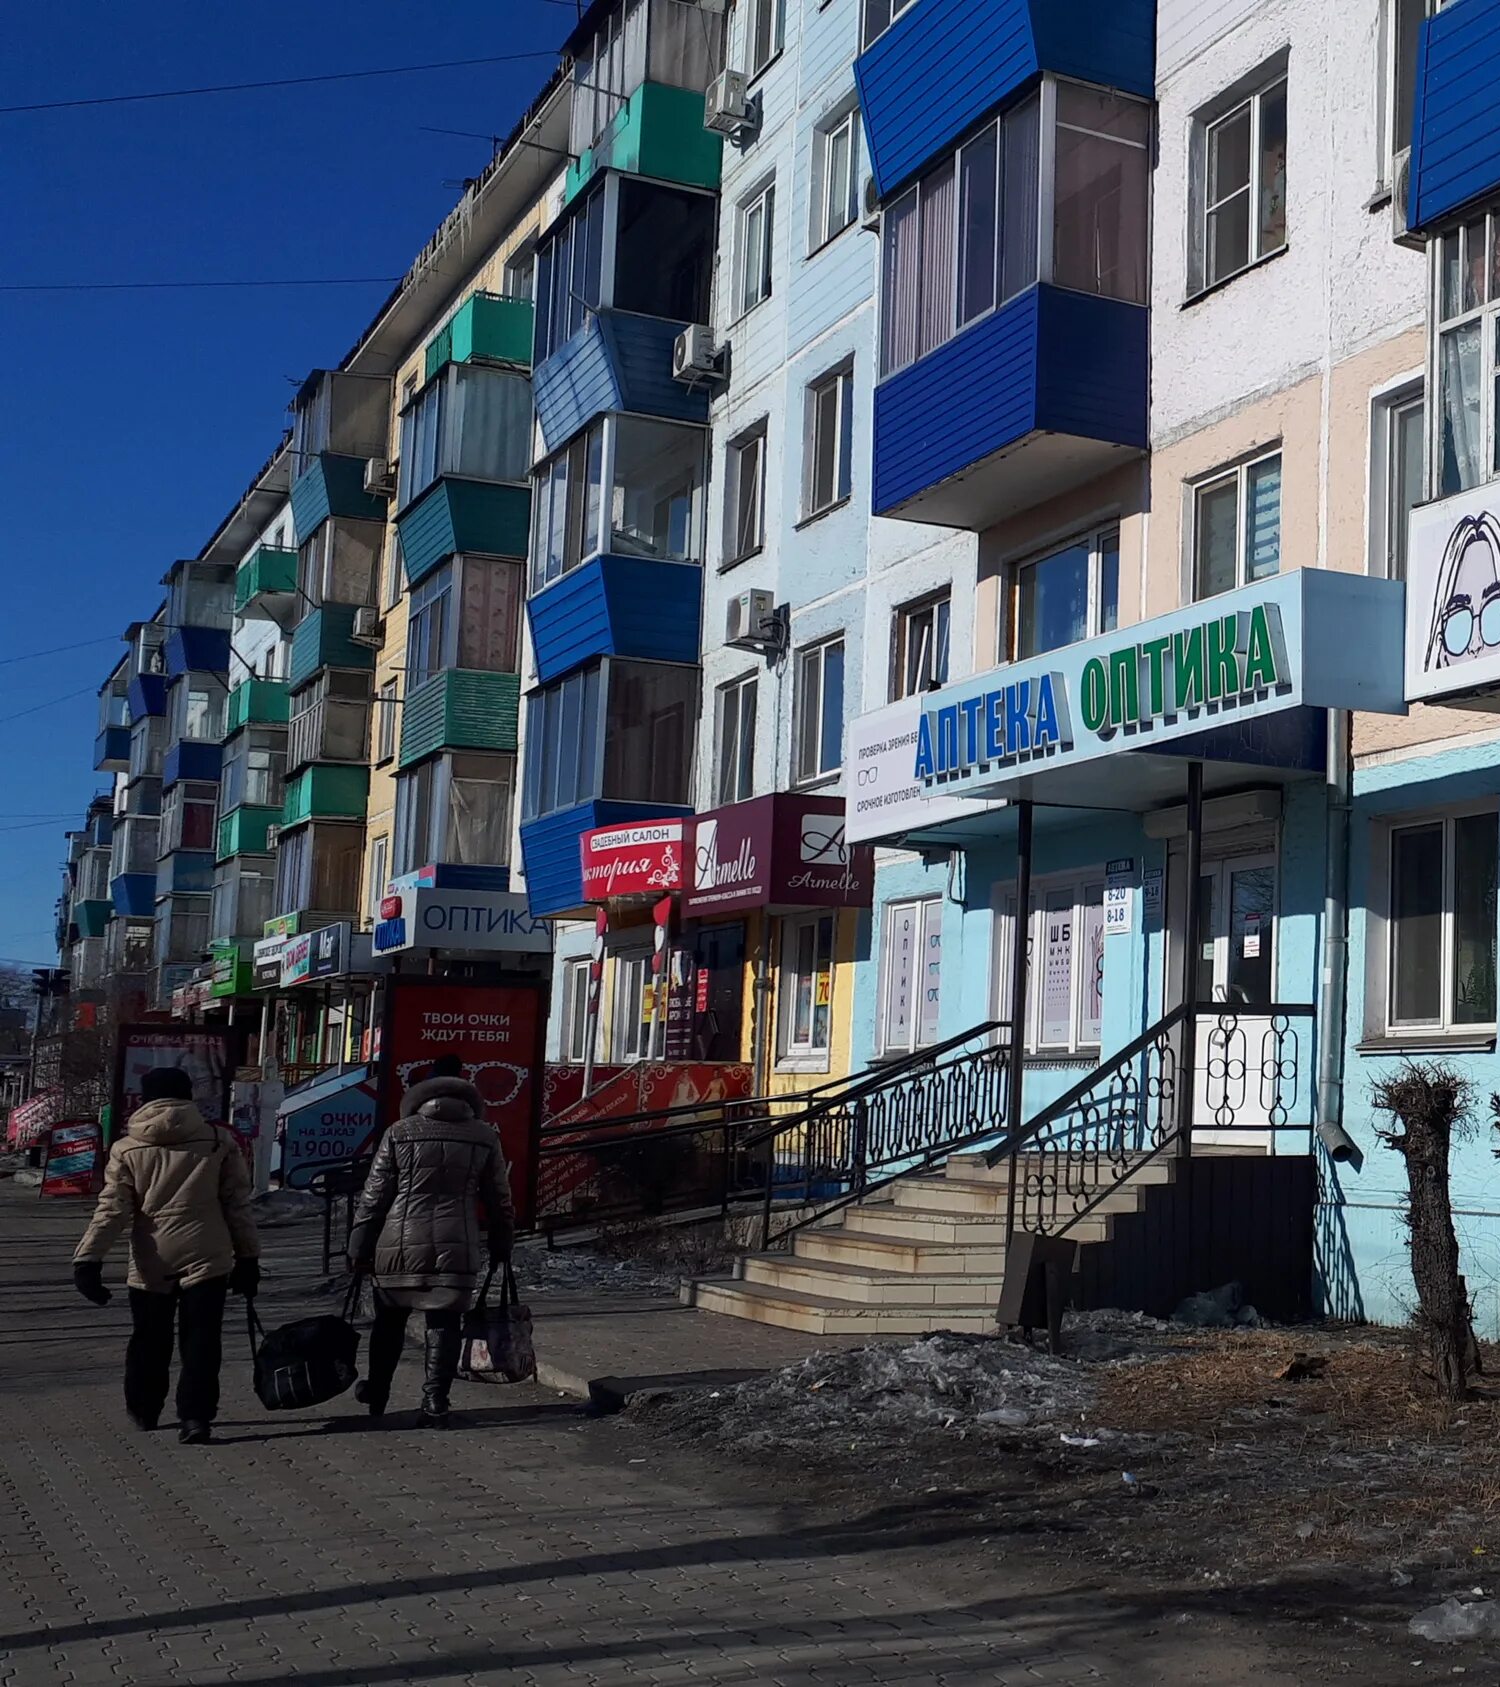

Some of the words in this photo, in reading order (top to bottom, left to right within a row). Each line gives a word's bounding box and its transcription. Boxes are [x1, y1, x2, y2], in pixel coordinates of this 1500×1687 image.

[914, 673, 1061, 780] АПТЕКА
[1080, 604, 1279, 734] ОПТИКА
[858, 741, 888, 761] ПРОВЕРКА
[888, 732, 910, 752] ЗРЕНИЯ
[856, 794, 883, 813] СРОЧНОЕ
[632, 828, 669, 842] САЛОН
[695, 821, 756, 890] Armelle
[583, 857, 652, 892] иктория
[787, 871, 860, 891] Armelle
[1108, 886, 1126, 901] 8-20
[423, 904, 550, 936] ОПТИКА
[1106, 908, 1125, 923] 8-18
[422, 1012, 464, 1025] ТВОИ
[467, 1013, 511, 1026] ОЧКИ
[420, 1028, 465, 1042] ЖДУТ
[469, 1030, 510, 1043] ТЕБЯ!
[321, 1112, 372, 1127] ОЧКИ
[298, 1128, 316, 1137] НА
[319, 1127, 356, 1137] ЗАКАЗ
